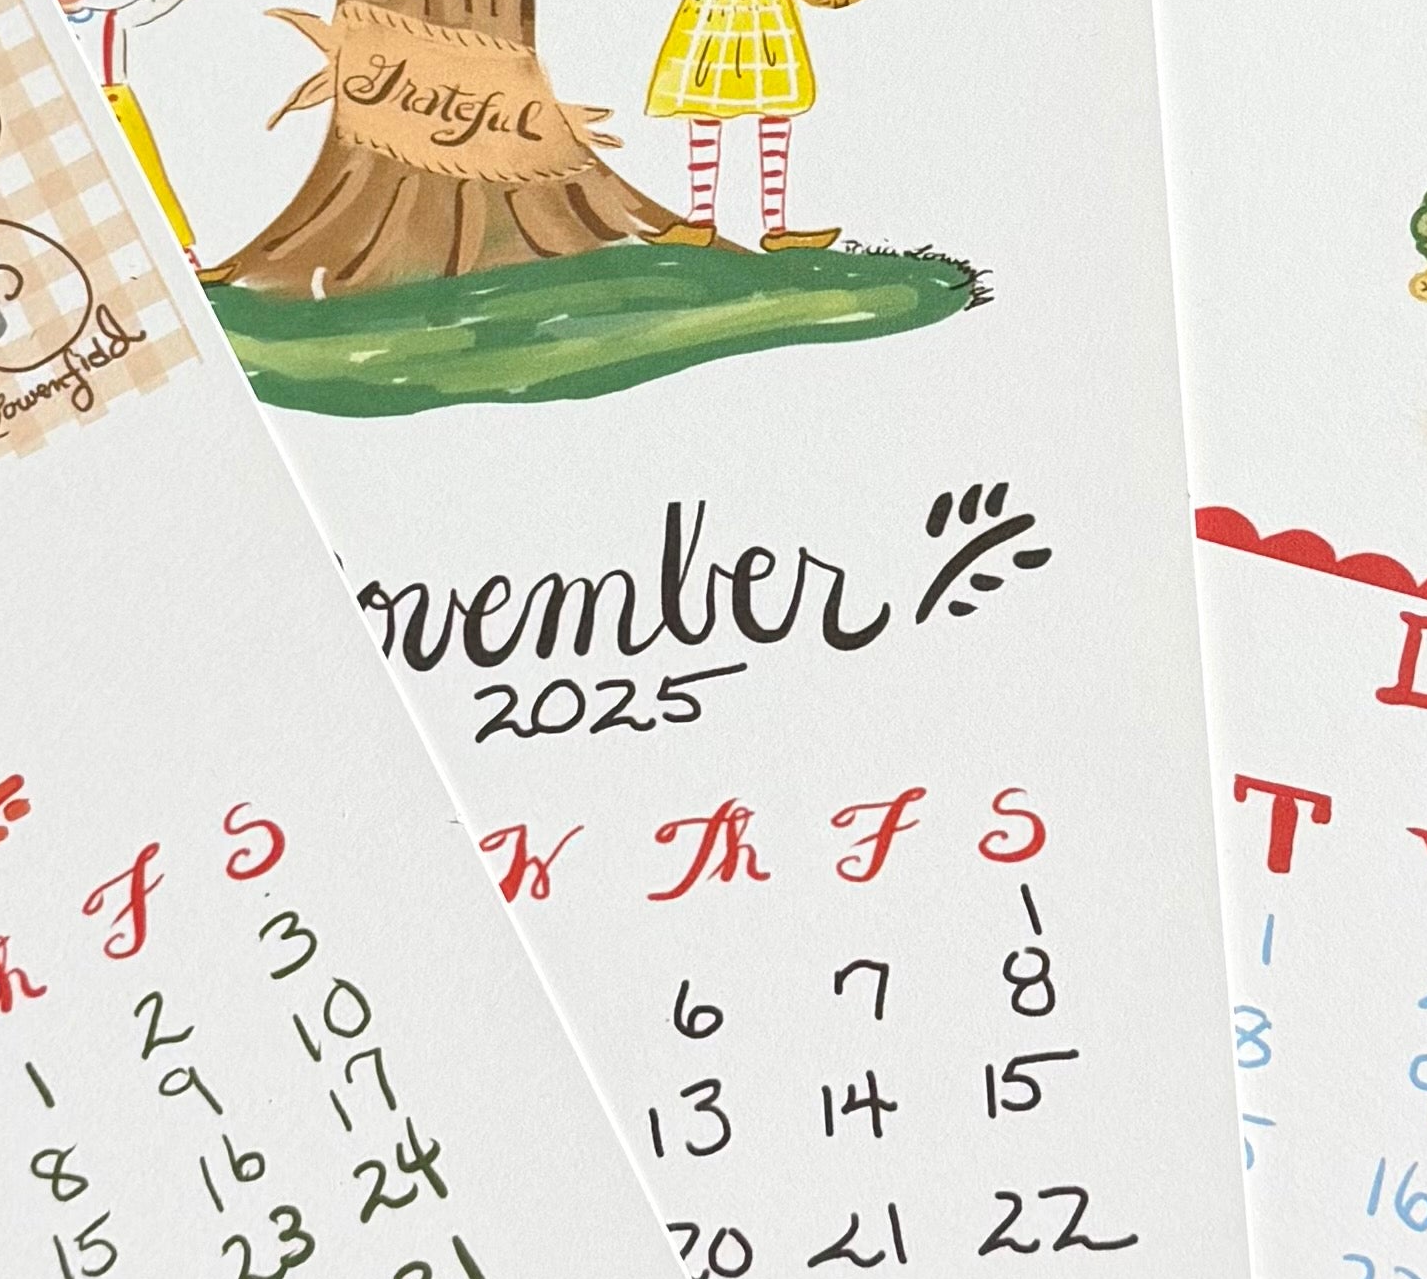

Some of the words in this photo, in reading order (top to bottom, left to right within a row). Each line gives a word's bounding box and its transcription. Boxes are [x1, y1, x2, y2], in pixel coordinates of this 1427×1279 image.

[342, 53, 543, 147] Grateful
[334, 499, 892, 673] ovember
[474, 662, 749, 743] 2025
[478, 823, 585, 904] W
[646, 797, 772, 903] Th
[829, 786, 928, 884] F
[977, 786, 1047, 864] S
[1232, 772, 1333, 875] T
[81, 841, 166, 961] F
[222, 801, 286, 882] S
[1019, 882, 1044, 937] 1
[673, 978, 725, 1040] 6
[833, 958, 891, 1022] 7
[1001, 945, 1057, 1018] 8
[1261, 913, 1275, 967] 1
[24, 1060, 56, 1110] 1
[132, 990, 196, 1062] 2
[257, 910, 319, 981] 3
[1233, 1004, 1272, 1068] 8
[29, 1143, 90, 1203] 8
[157, 1065, 224, 1117] 9
[291, 976, 378, 1064] 10
[198, 1134, 266, 1214] 16
[328, 1046, 396, 1133] 17
[647, 1077, 732, 1159] 13
[820, 1069, 899, 1140] 14
[984, 1048, 1080, 1120] 15
[351, 1116, 449, 1225] 24
[806, 1201, 908, 1269] 21
[977, 1185, 1140, 1257] 22
